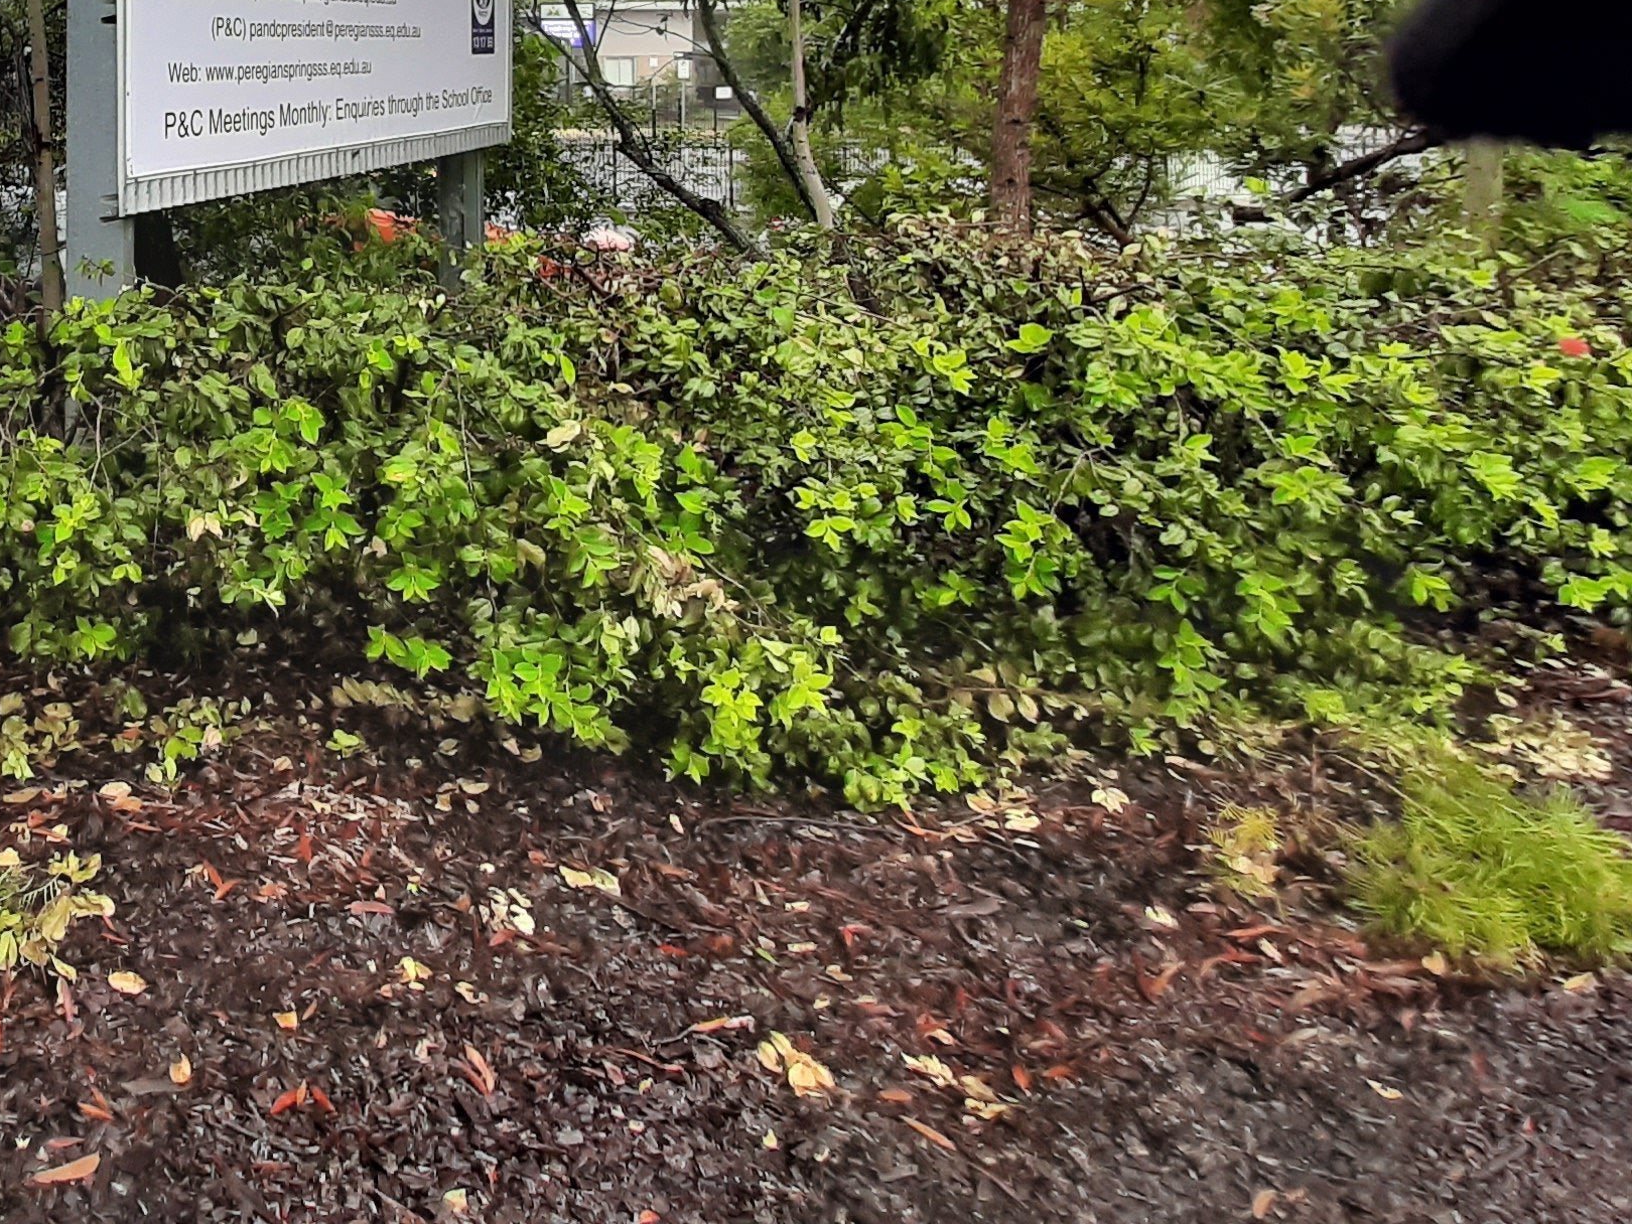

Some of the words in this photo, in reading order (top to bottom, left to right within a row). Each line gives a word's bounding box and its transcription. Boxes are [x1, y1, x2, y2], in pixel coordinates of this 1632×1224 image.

[211, 16, 246, 41] (P&C)
[168, 61, 202, 83] Web:
[165, 109, 203, 140] P&C
[209, 106, 275, 136] Meetings
[279, 100, 332, 128] Monthly:
[336, 95, 385, 123] Enquiries
[388, 91, 423, 118] through
[426, 91, 439, 110] the
[442, 87, 468, 108] School
[470, 85, 492, 104] Office
